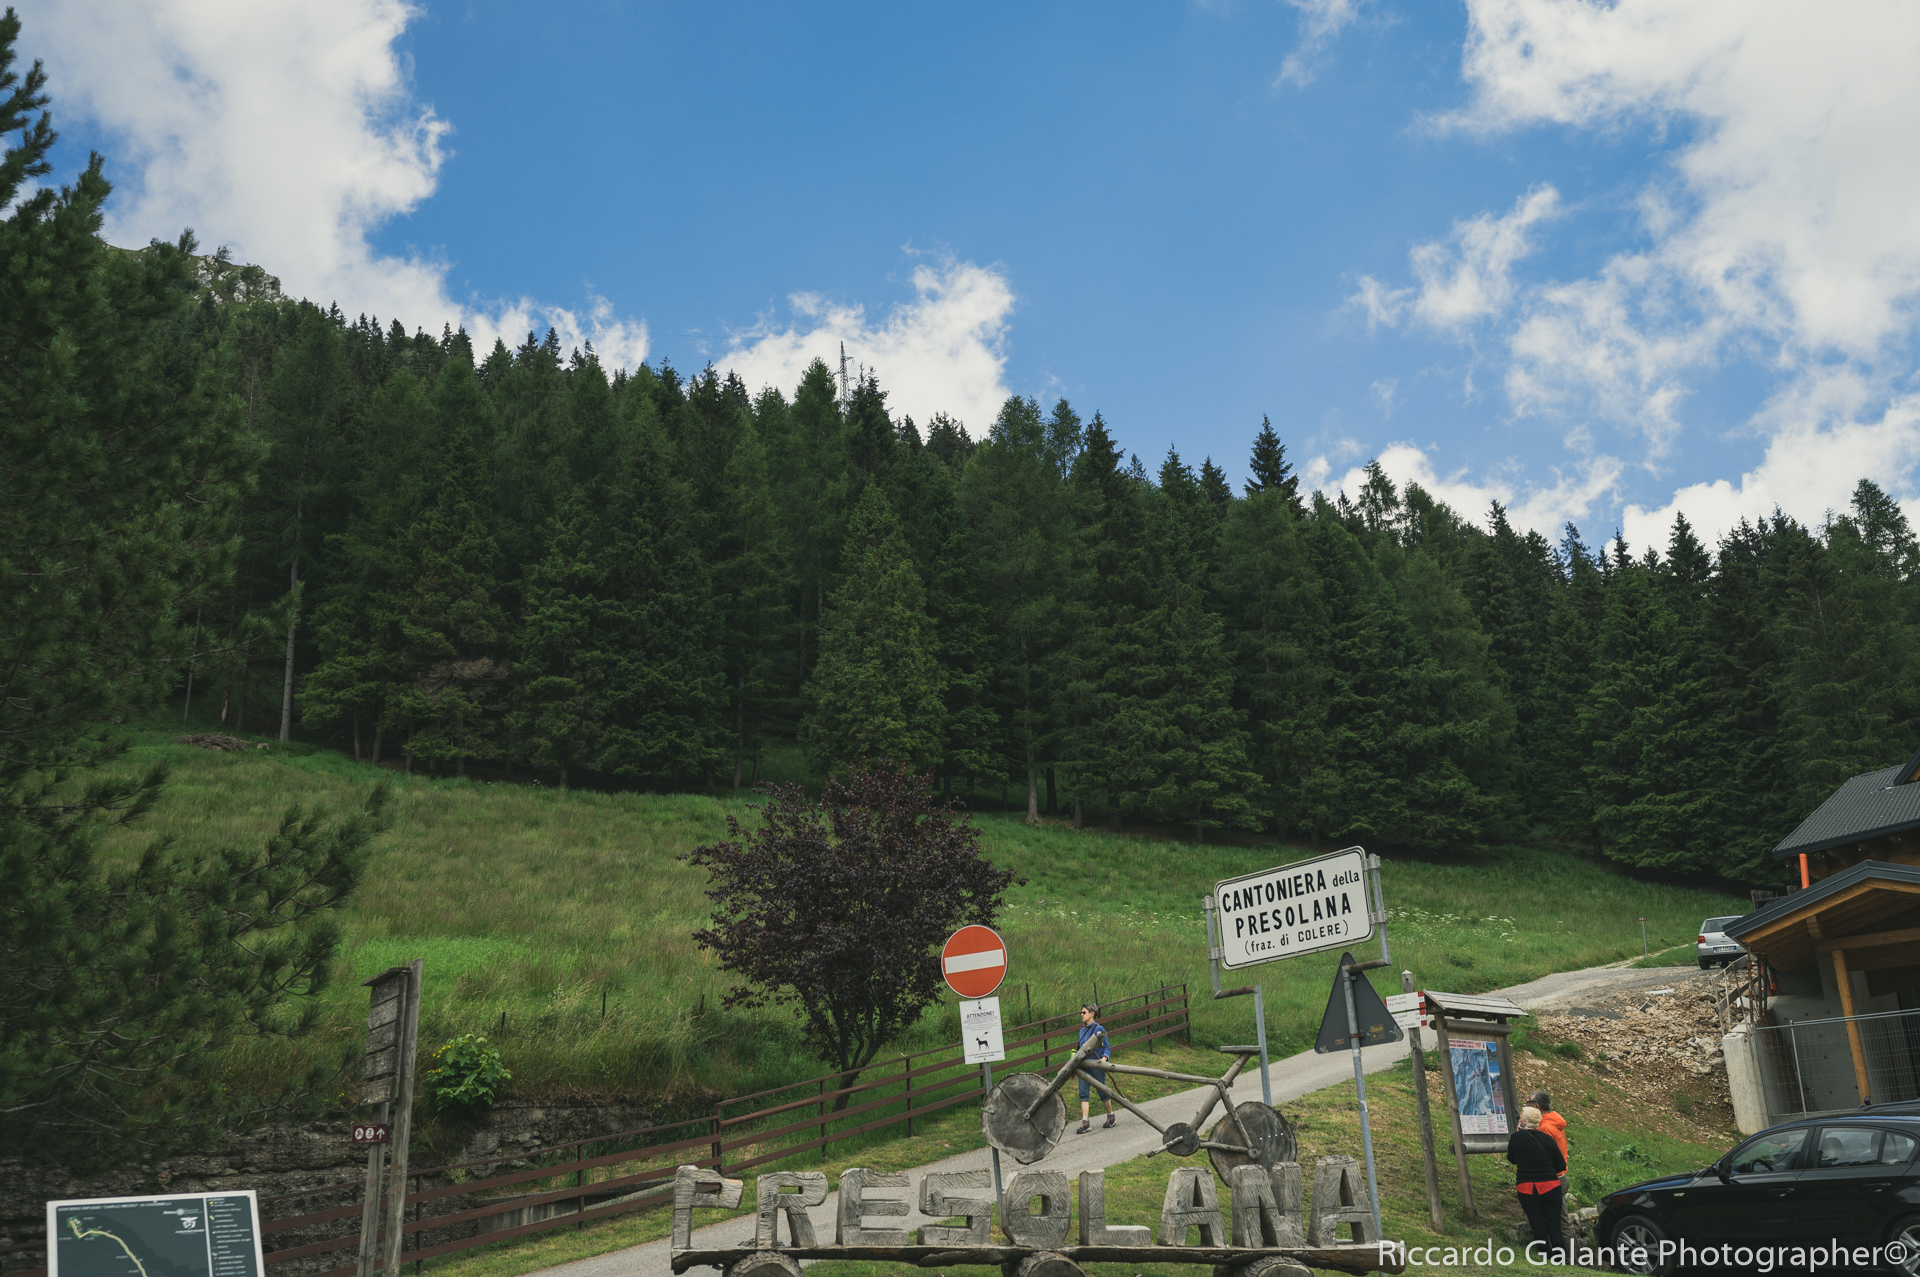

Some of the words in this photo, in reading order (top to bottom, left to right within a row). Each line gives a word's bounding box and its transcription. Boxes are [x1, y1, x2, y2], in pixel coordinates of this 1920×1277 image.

[1222, 869, 1327, 913] CANTONIERA
[1332, 870, 1360, 887] della
[1235, 892, 1352, 938] PRESOLANA
[1244, 940, 1275, 956] (fraz.
[1280, 934, 1289, 946] di
[1298, 919, 1349, 942] COLERE)
[672, 1156, 1376, 1249] PRESOLANA
